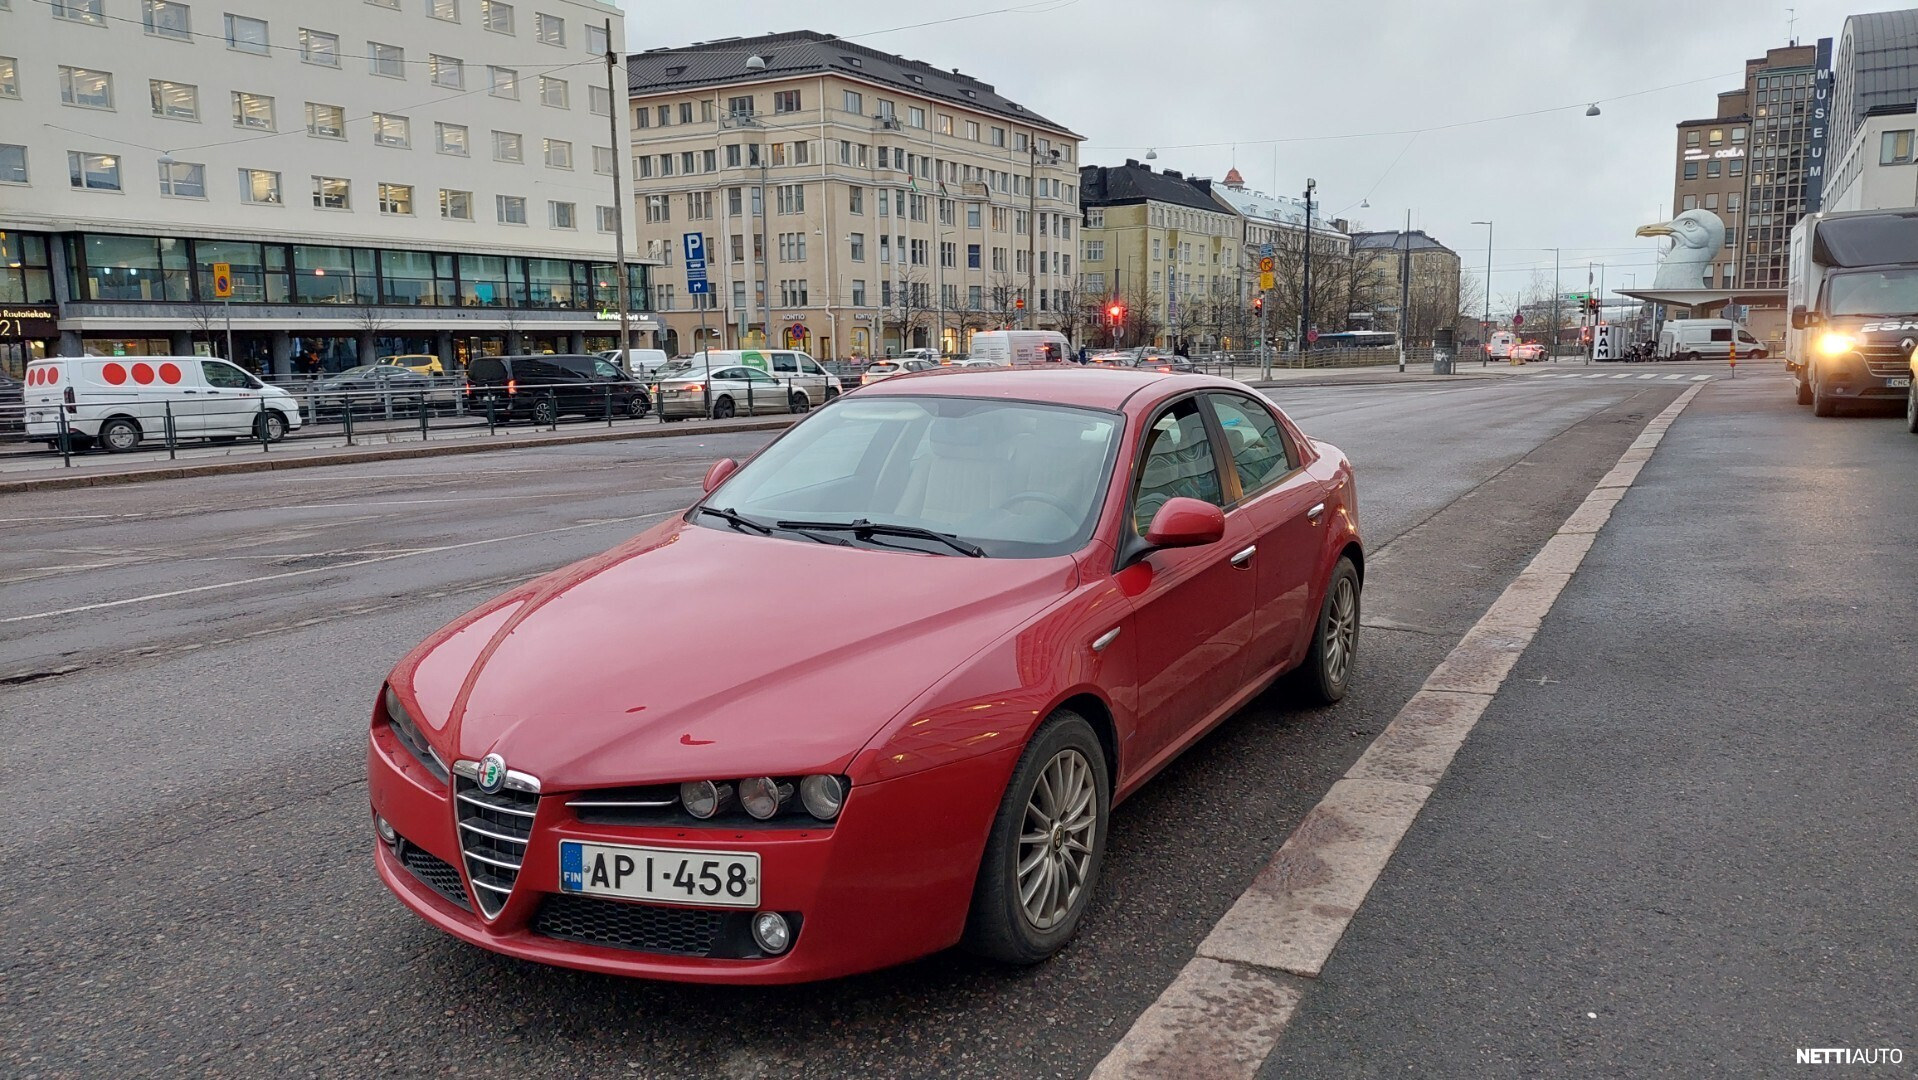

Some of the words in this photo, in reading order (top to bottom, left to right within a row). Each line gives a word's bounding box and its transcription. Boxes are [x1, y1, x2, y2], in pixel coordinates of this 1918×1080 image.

[1810, 69, 1829, 177] MUSEUM
[687, 235, 700, 258] P
[3, 310, 51, 318] Rautatiekatu
[0, 320, 21, 336] 21
[1597, 327, 1609, 358] HAM
[563, 871, 582, 883] FIN
[590, 852, 748, 898] API-458
